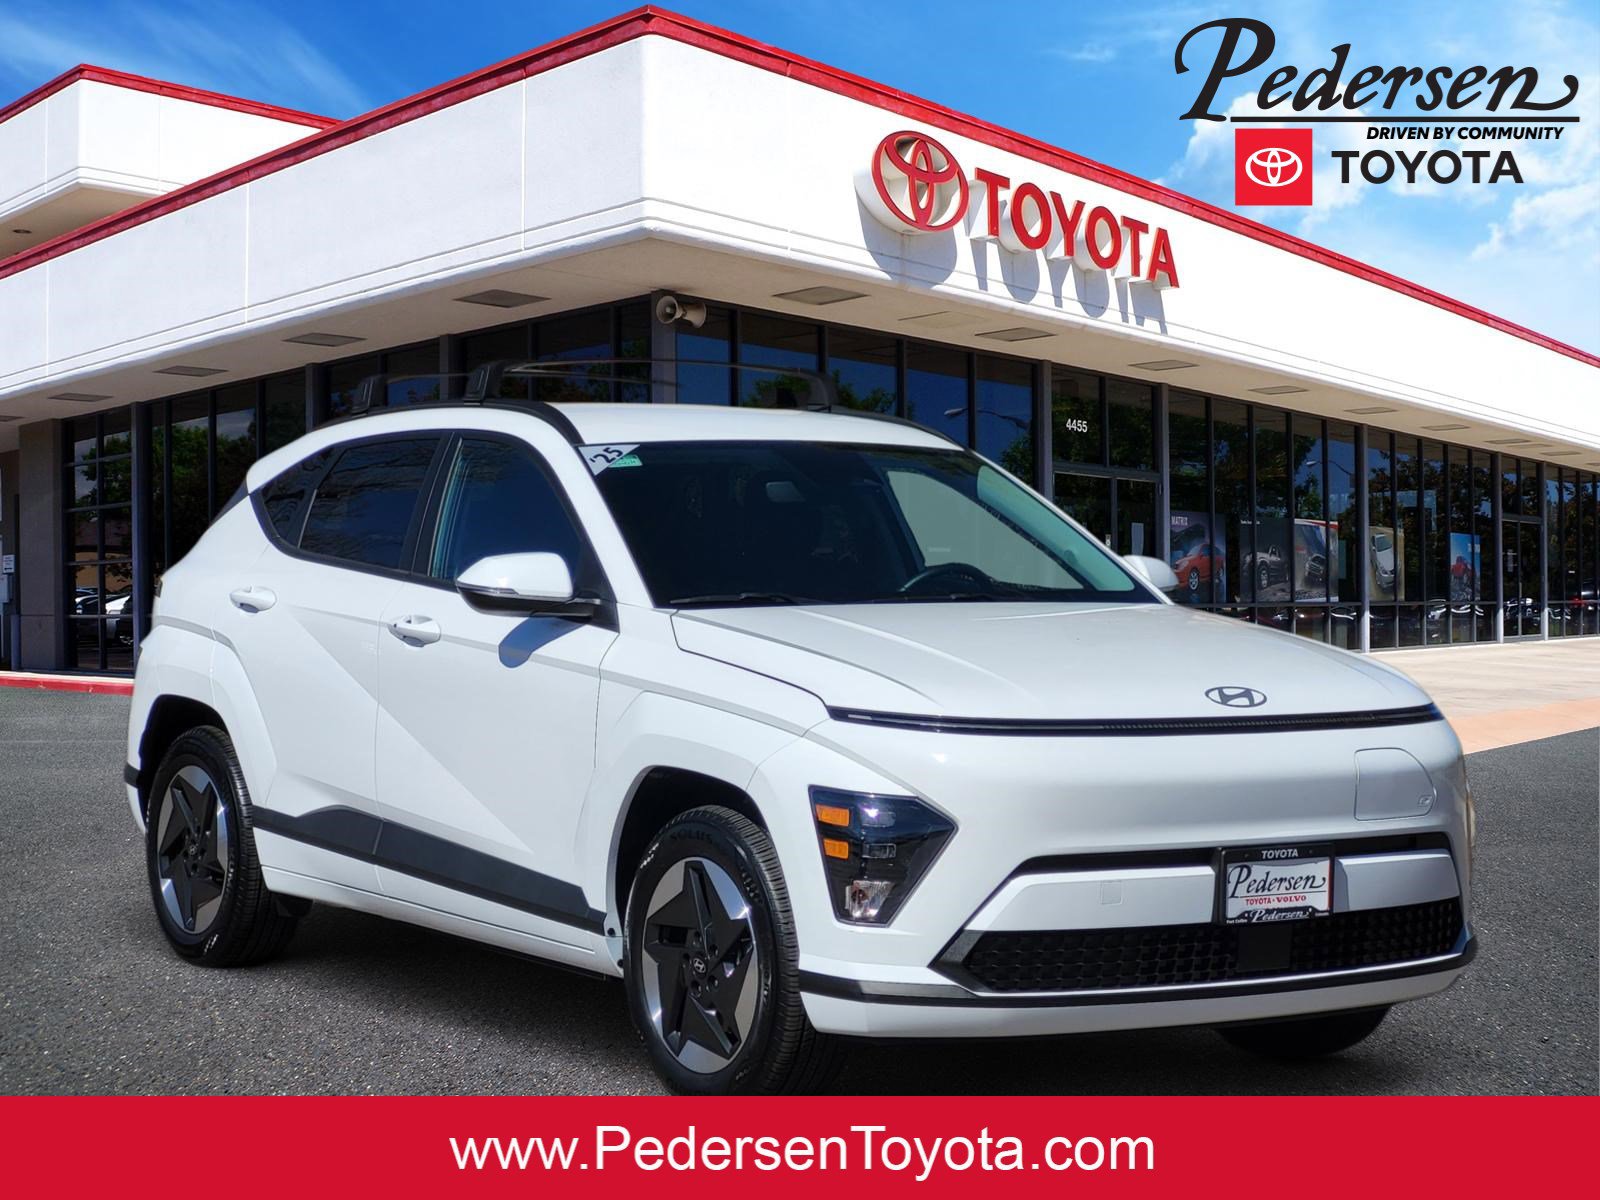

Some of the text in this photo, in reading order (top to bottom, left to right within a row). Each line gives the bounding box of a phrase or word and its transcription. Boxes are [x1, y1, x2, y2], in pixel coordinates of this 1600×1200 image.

[974, 167, 1180, 289] TOYOTA
[1065, 418, 1088, 433] 4455
[1171, 515, 1188, 526] MATRIX
[1262, 848, 1299, 859] TOYOTA
[1227, 864, 1327, 898] Pedersen
[1249, 908, 1310, 923] Pedersen
